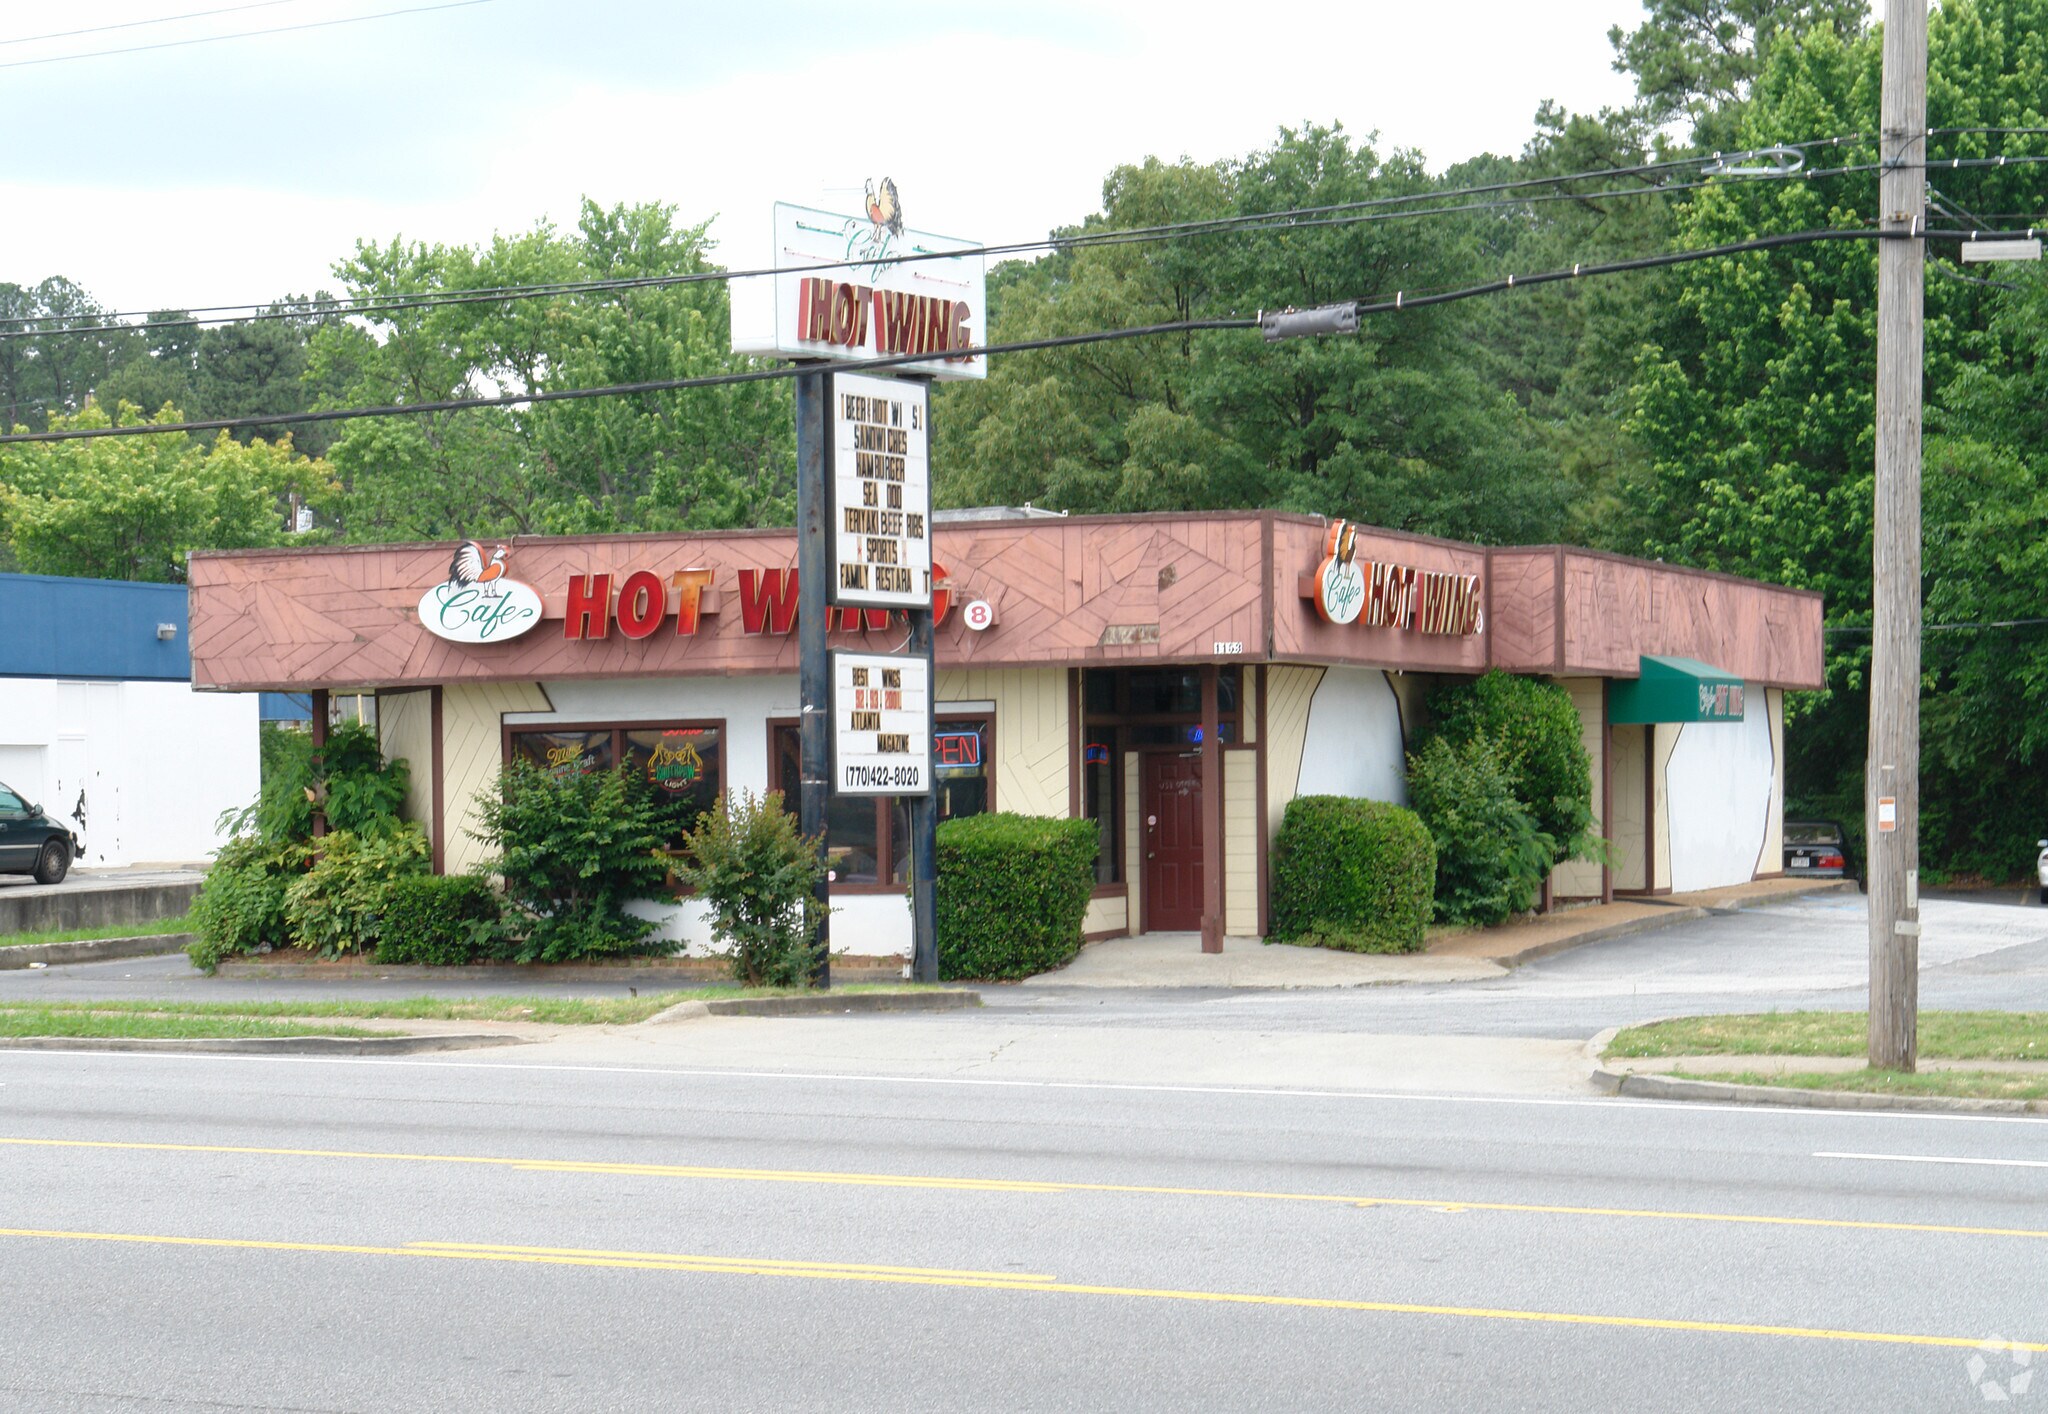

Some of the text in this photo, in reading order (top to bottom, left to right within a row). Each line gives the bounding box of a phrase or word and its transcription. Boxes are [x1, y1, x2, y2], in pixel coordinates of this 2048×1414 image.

[799, 277, 971, 363] HOT WING
[846, 394, 866, 423] BEER
[872, 398, 887, 426] HOT
[854, 424, 907, 456] SANDWICHES
[856, 451, 905, 483] HAMBURGER
[863, 480, 878, 508] SEA
[844, 507, 923, 539] TERIYAKI BEEF RIBS
[867, 538, 898, 565] SPORTS
[840, 563, 869, 592] FAMILY
[563, 570, 716, 639] HOT
[1327, 567, 1361, 619] Cafe
[1366, 561, 1481, 635] HOT WING
[436, 585, 533, 638] Cafe
[971, 606, 987, 624] 8
[852, 667, 869, 687] BEST
[850, 711, 881, 732] ATLANTA
[877, 733, 910, 754] MAGAZINE
[664, 778, 688, 791] LIGHT
[846, 766, 919, 787] (770)422-8020
